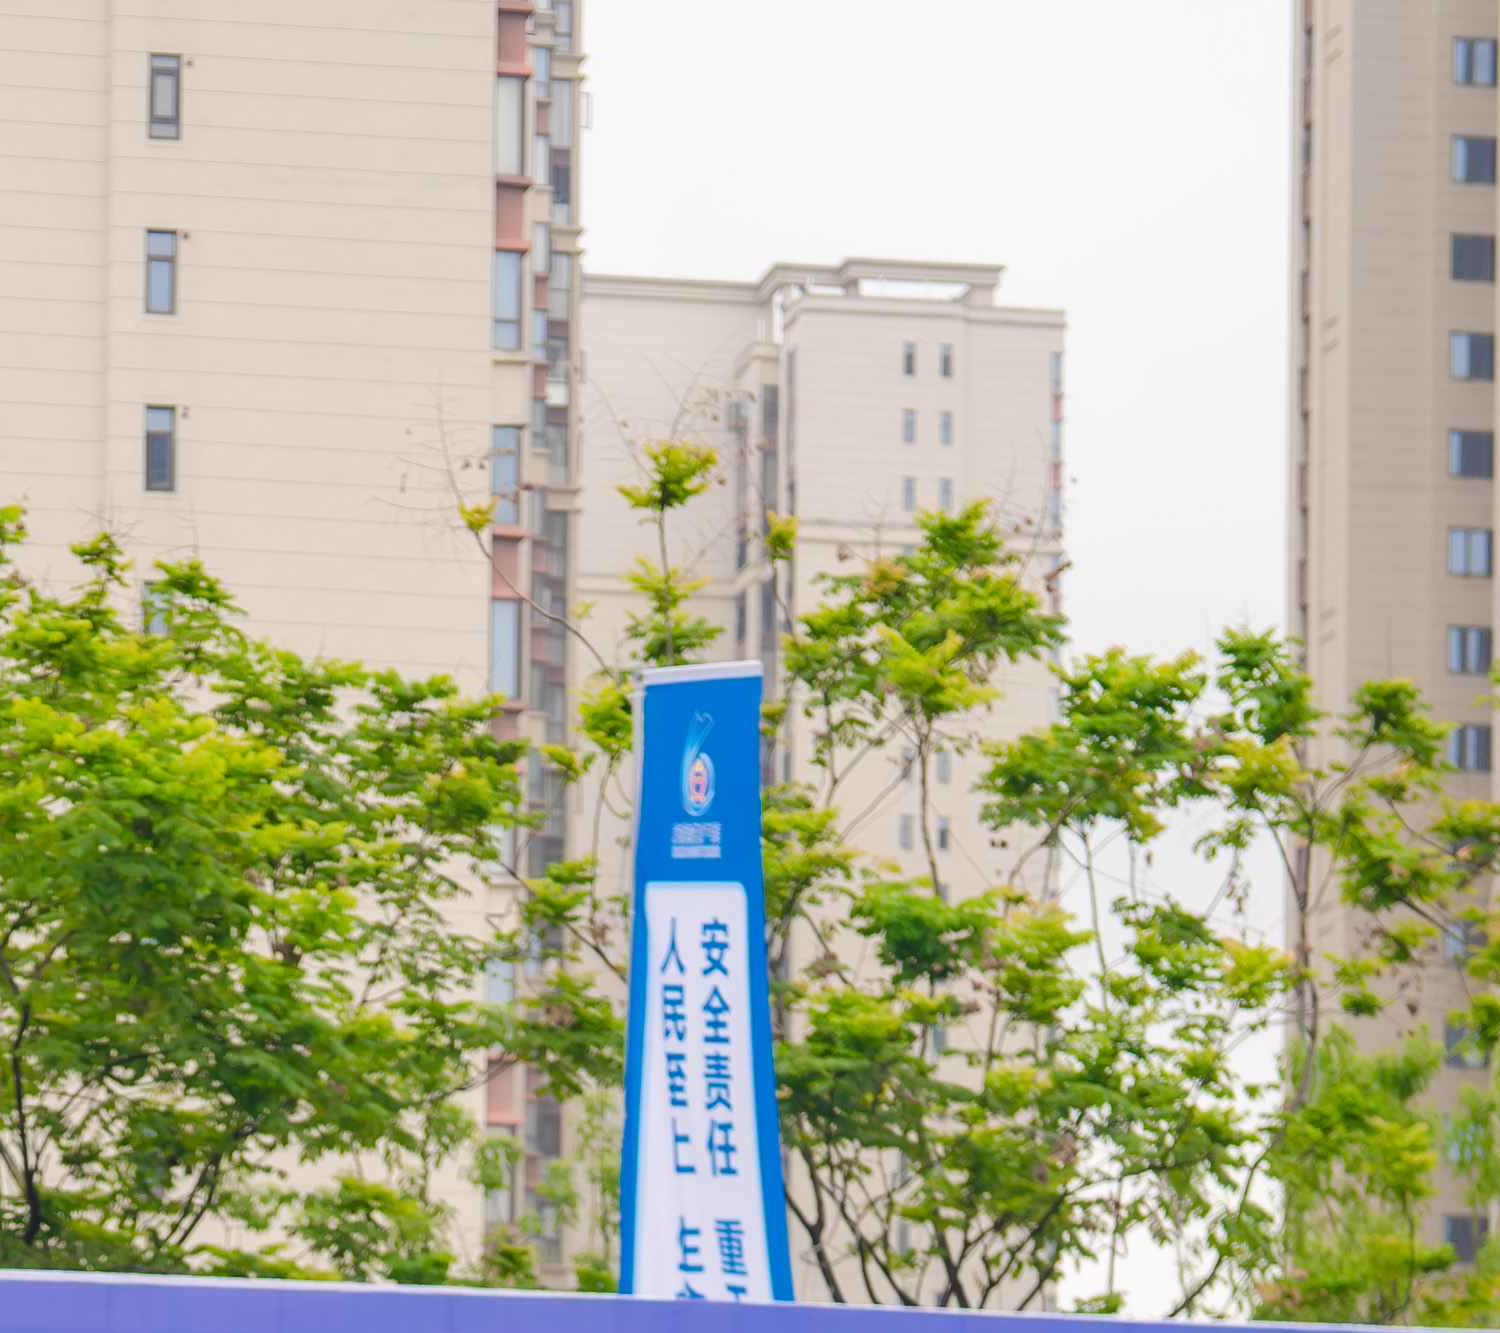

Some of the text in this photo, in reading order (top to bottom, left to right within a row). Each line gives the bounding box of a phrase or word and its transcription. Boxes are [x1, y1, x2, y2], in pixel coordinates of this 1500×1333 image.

[660, 916, 697, 1175] 人民至上
[699, 917, 738, 1177] 安全责任
